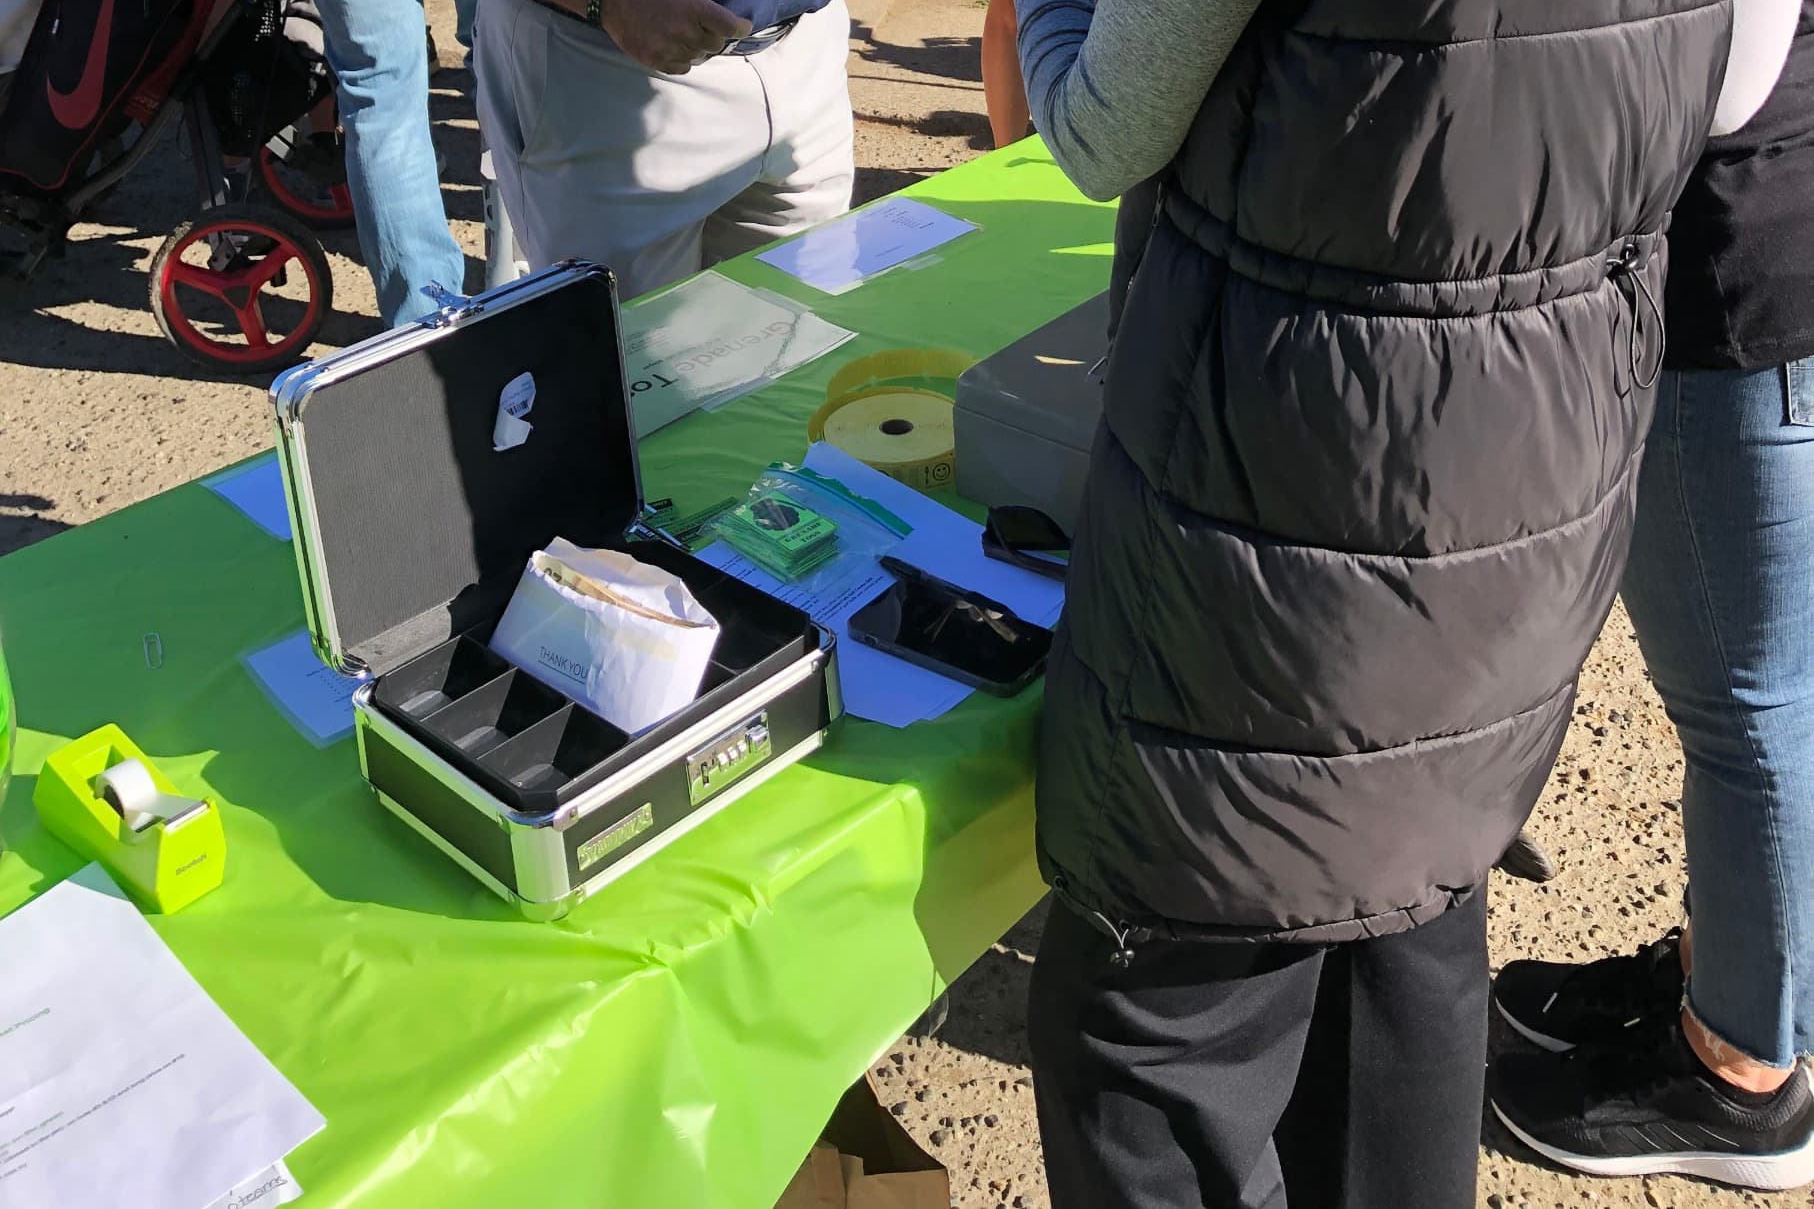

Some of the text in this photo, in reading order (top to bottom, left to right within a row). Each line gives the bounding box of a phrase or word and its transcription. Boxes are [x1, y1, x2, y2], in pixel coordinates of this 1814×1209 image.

[673, 320, 795, 373] Grenade
[630, 373, 679, 398] To
[538, 645, 589, 679] THANK YOU
